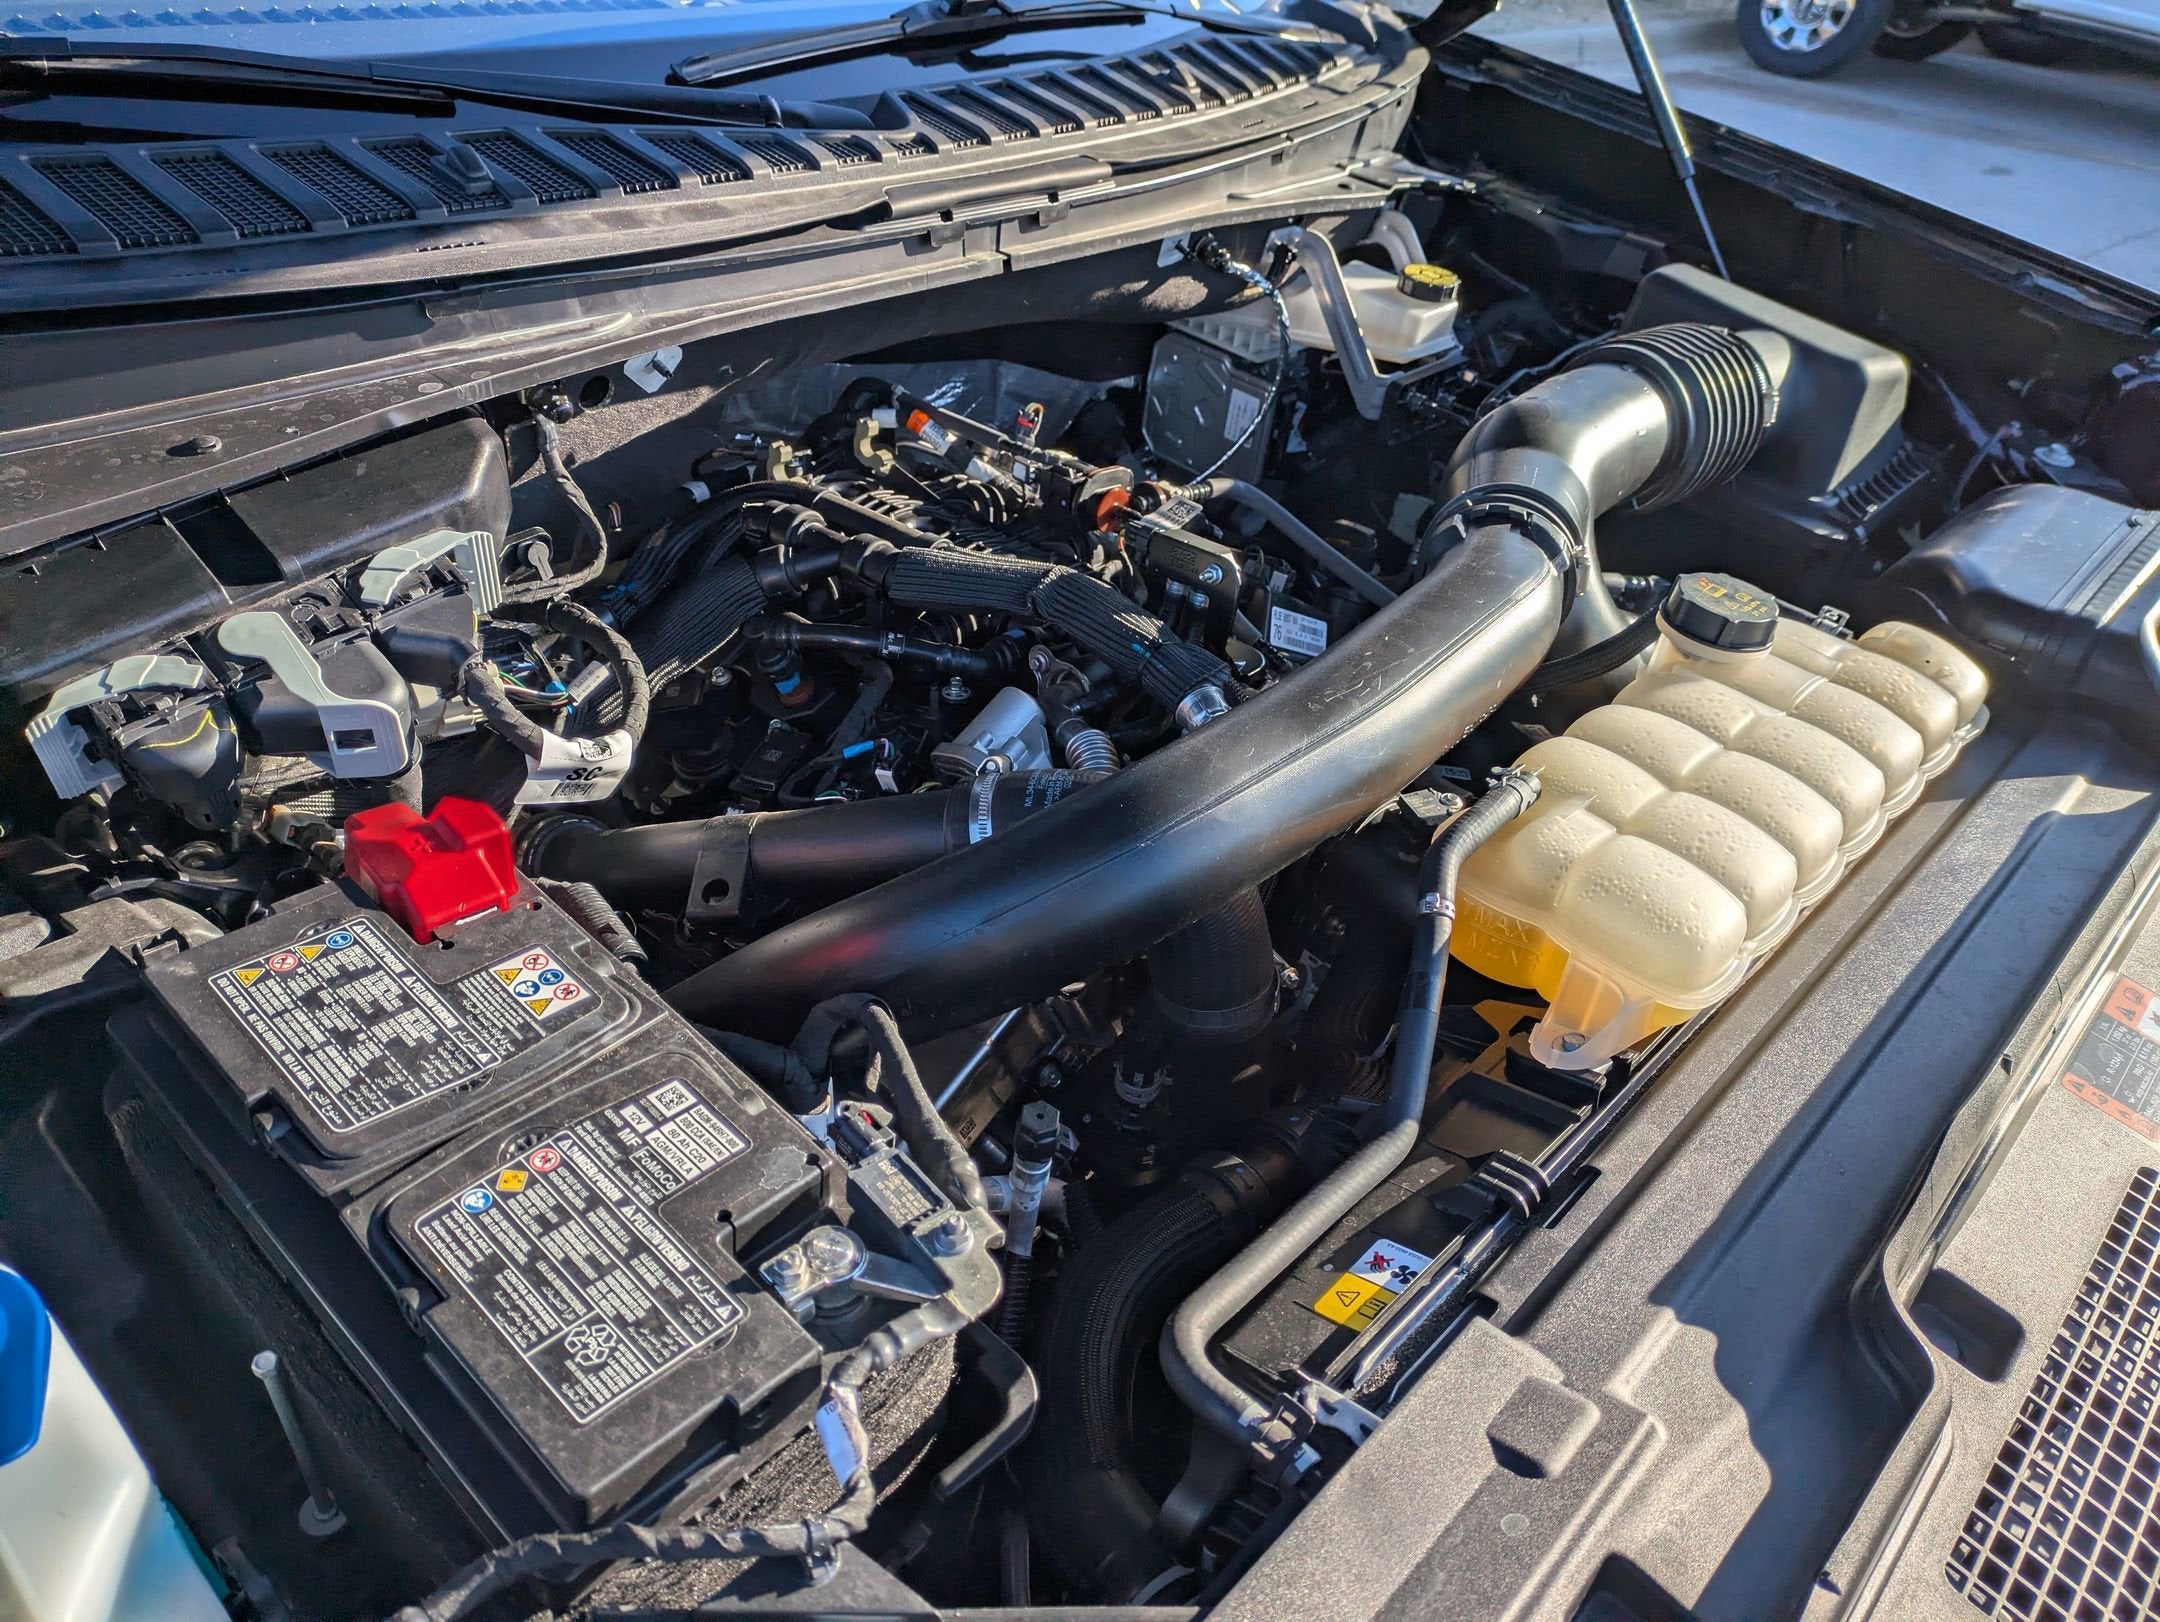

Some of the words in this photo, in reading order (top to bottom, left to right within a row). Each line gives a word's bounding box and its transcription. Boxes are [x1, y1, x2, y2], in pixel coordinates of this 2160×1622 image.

[566, 766, 603, 781] SC
[1476, 906, 1528, 943] MAX
[1467, 932, 1520, 967] MIN
[215, 977, 231, 987] DO
[357, 930, 407, 973] DANGER/POISON
[407, 981, 459, 1028] PELIGRO/VENENO
[222, 985, 240, 998] NOT
[231, 995, 253, 1014] OPEN.
[246, 1012, 261, 1022] NE
[252, 1020, 270, 1033] PAS
[261, 1030, 288, 1054] OUVRIR.
[280, 1053, 296, 1064] NO
[287, 1061, 303, 1072] LA
[294, 1069, 318, 1090] ABRA.
[626, 1110, 646, 1126] 12V
[678, 1116, 695, 1129] 800
[689, 1126, 707, 1140] CCA
[615, 1127, 644, 1150] MF
[666, 1127, 681, 1139] 80
[676, 1137, 692, 1150] Ah
[687, 1147, 708, 1164] C20
[648, 1134, 695, 1175] AGM/VRLA
[634, 1150, 679, 1190] FoMoCo
[564, 1145, 625, 1202] DANGER/POISON
[628, 1212, 693, 1272] PELIGRO/VENENO
[420, 1224, 438, 1241] ANTI
[440, 1213, 458, 1230] Lead
[452, 1227, 469, 1242] Acid
[462, 1240, 486, 1263] Battery
[449, 1208, 494, 1256] NON-SPILLABLE
[501, 1268, 528, 1295] CONTRA
[523, 1293, 559, 1331] DERRAMES
